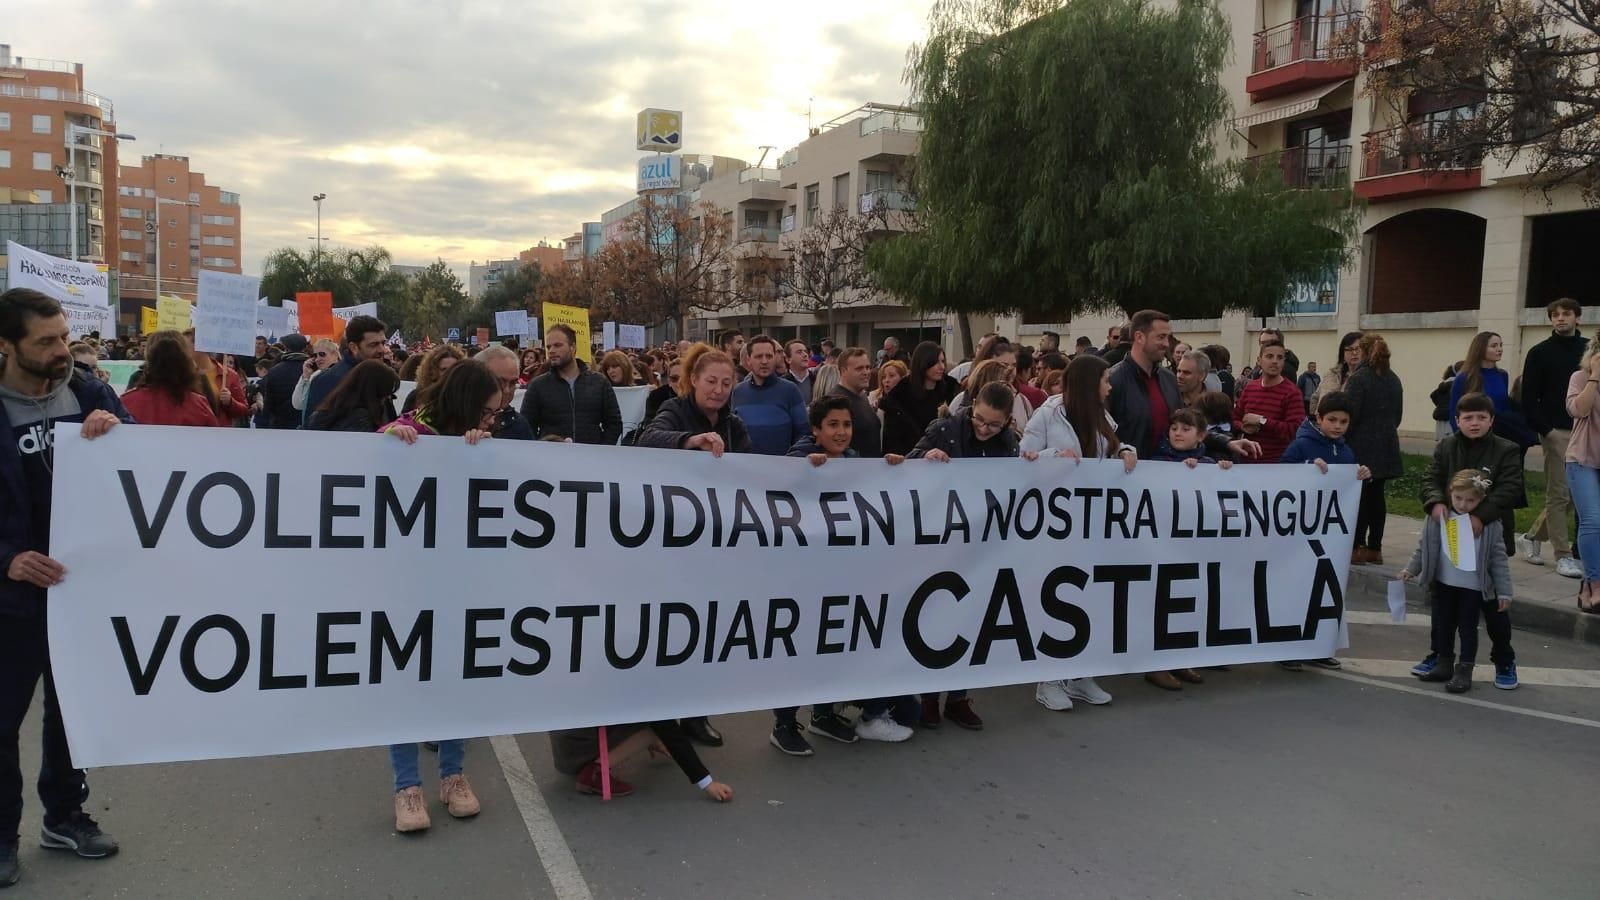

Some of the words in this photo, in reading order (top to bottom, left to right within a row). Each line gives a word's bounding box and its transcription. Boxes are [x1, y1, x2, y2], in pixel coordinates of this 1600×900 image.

[641, 157, 672, 180] azul
[118, 469, 438, 549] VOLEM
[467, 478, 809, 548] ESTUDIAR
[819, 490, 895, 547] EN
[910, 489, 971, 546] LA
[982, 487, 1159, 541] NOSTRA
[1171, 489, 1349, 539] LLENGUA
[111, 609, 434, 696] VOLEM
[463, 597, 801, 680] ESTUDIAR
[816, 593, 889, 656] EN
[902, 540, 1344, 670] CASTELLÀ
